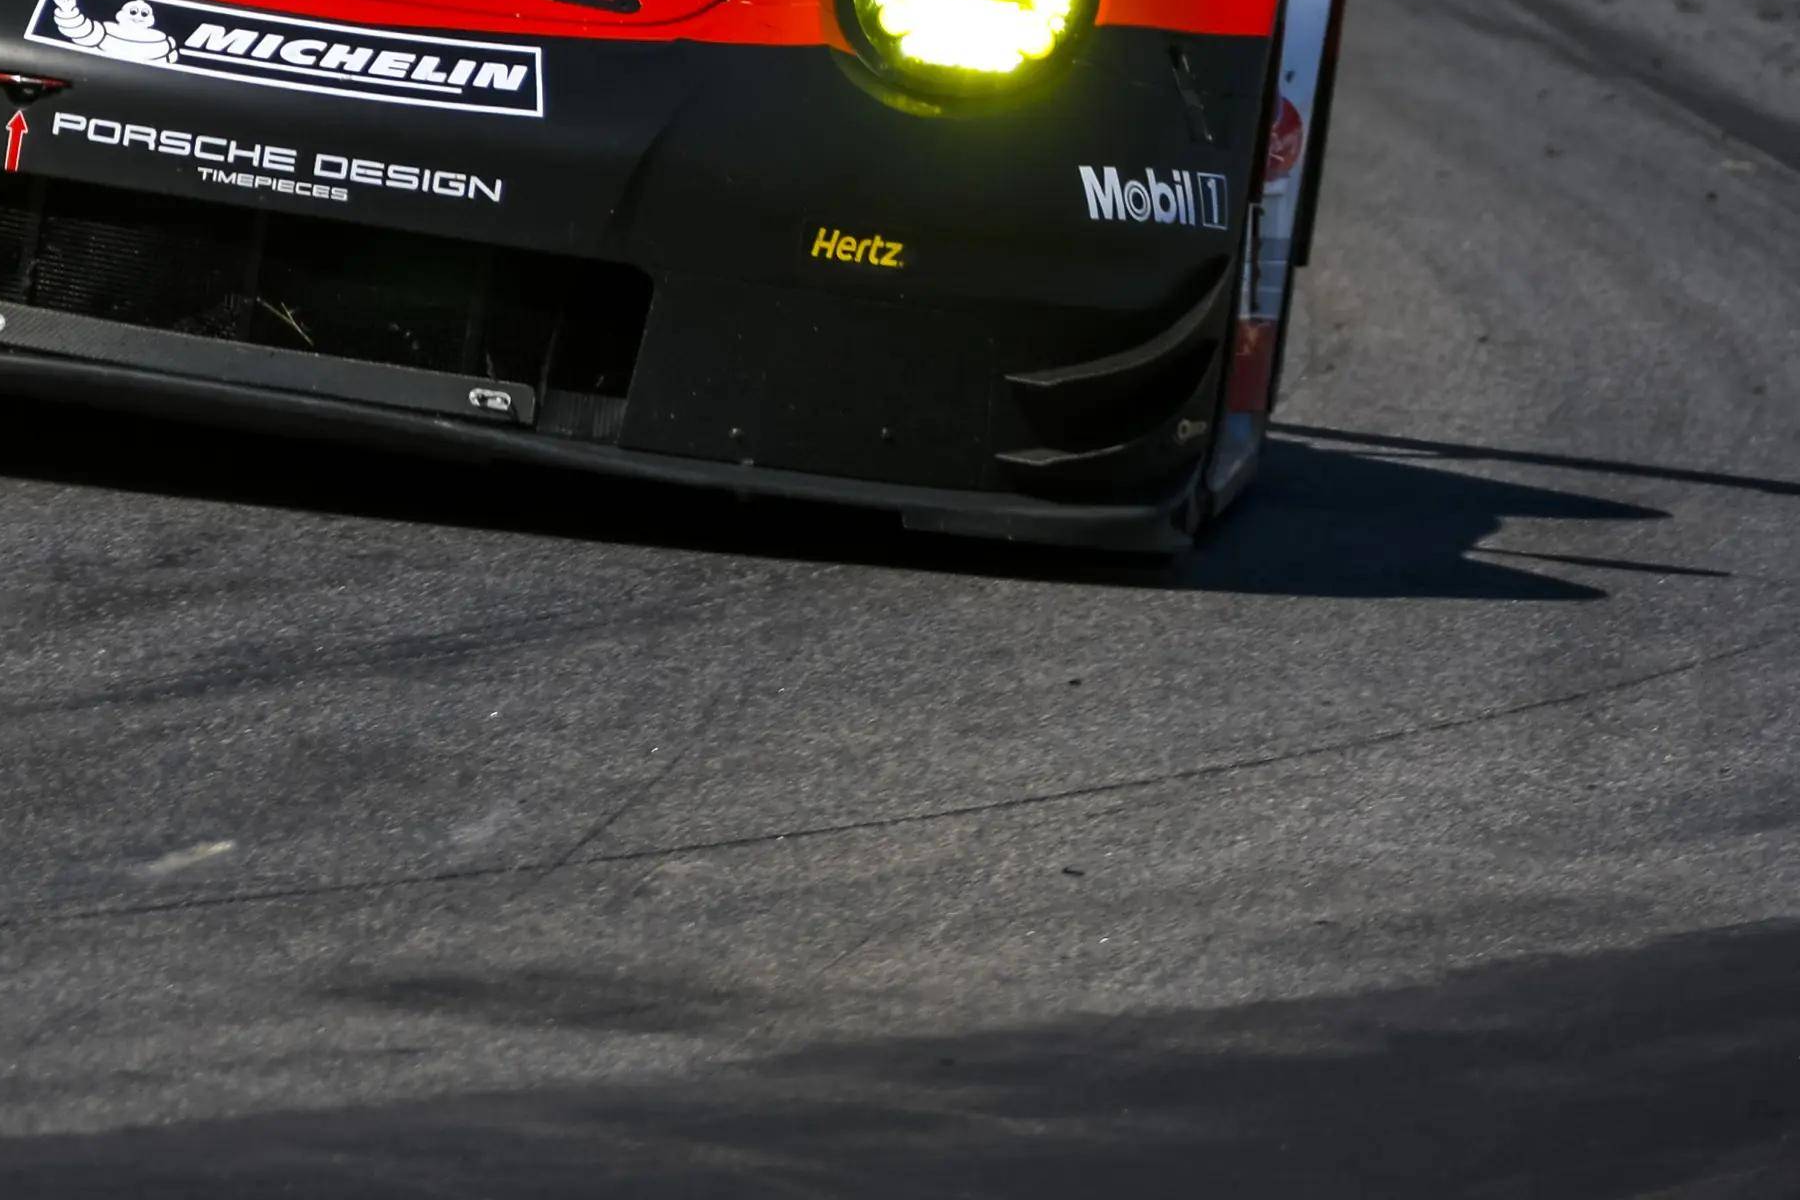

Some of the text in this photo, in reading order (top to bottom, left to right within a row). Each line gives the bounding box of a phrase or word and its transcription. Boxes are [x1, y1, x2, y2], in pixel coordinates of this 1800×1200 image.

[184, 22, 528, 92] MICHELIN
[51, 111, 503, 202] PORSCHE DESIGN
[196, 166, 349, 202] TIMEPIECES
[1077, 164, 1196, 227] Mobil
